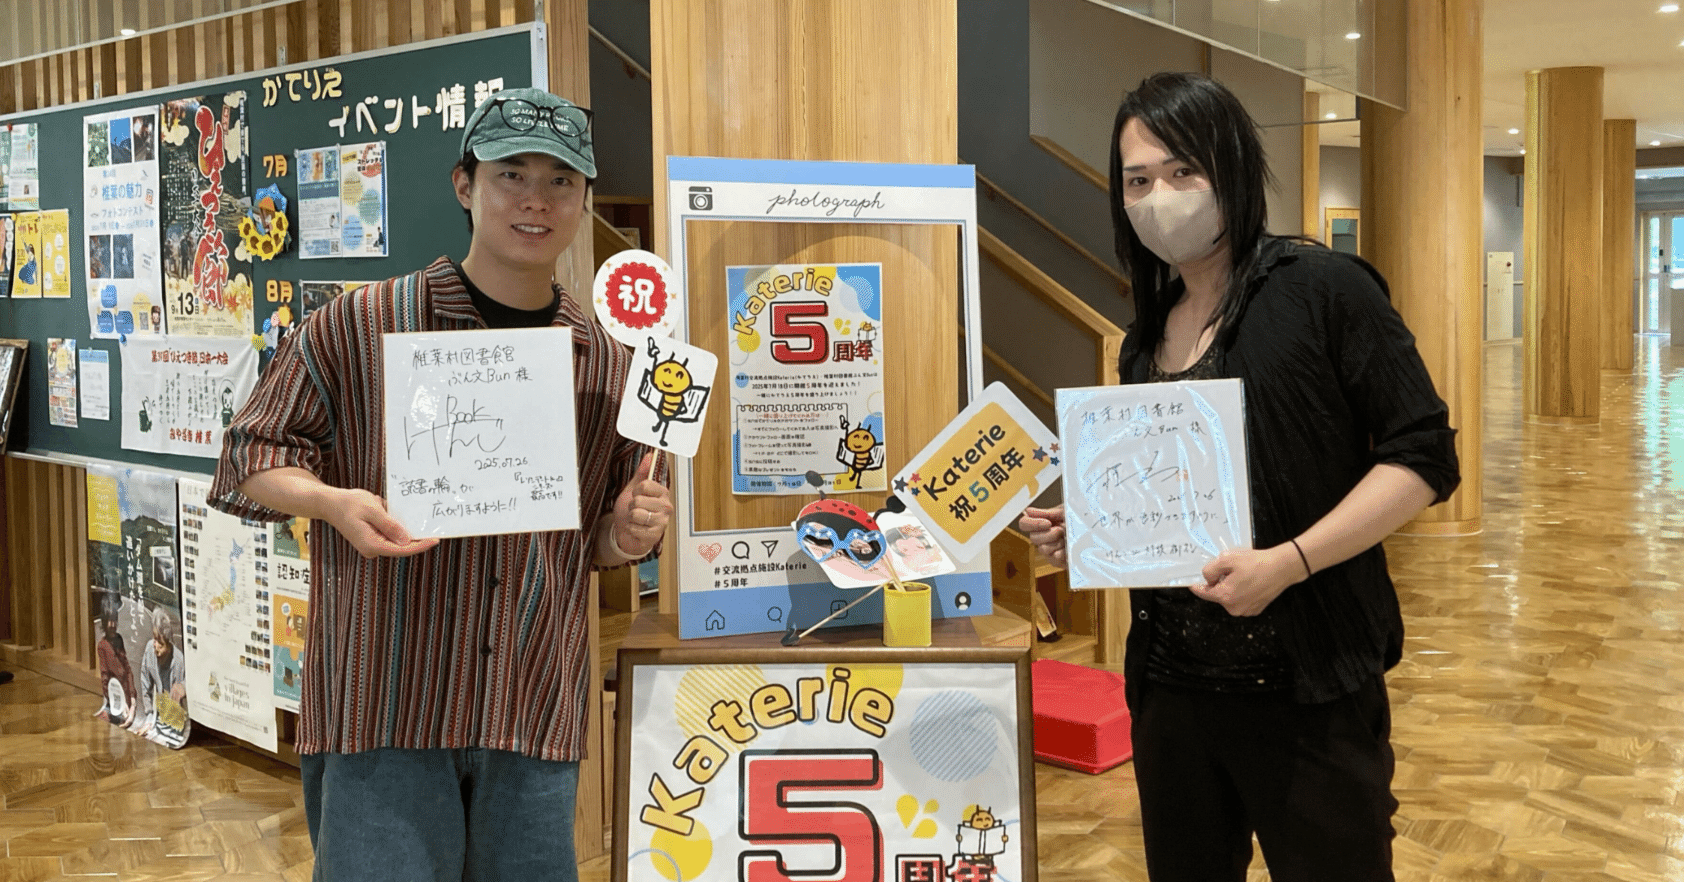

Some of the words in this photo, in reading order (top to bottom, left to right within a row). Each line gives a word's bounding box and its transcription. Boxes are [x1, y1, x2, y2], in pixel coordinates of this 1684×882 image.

[262, 67, 343, 107] かてりえ
[328, 77, 505, 138] イベント情報
[263, 154, 288, 178] 7月
[766, 189, 885, 217] photograph
[266, 280, 293, 303] 8月
[618, 275, 657, 315] 祝
[733, 268, 833, 336] Katerie
[413, 345, 515, 370] 椎葉村図書館
[446, 394, 491, 424] Book
[475, 457, 529, 471] 2025.07.26
[923, 424, 1006, 501] Katerie
[949, 447, 1025, 522] 祝5周年
[639, 667, 895, 836] Katerie
